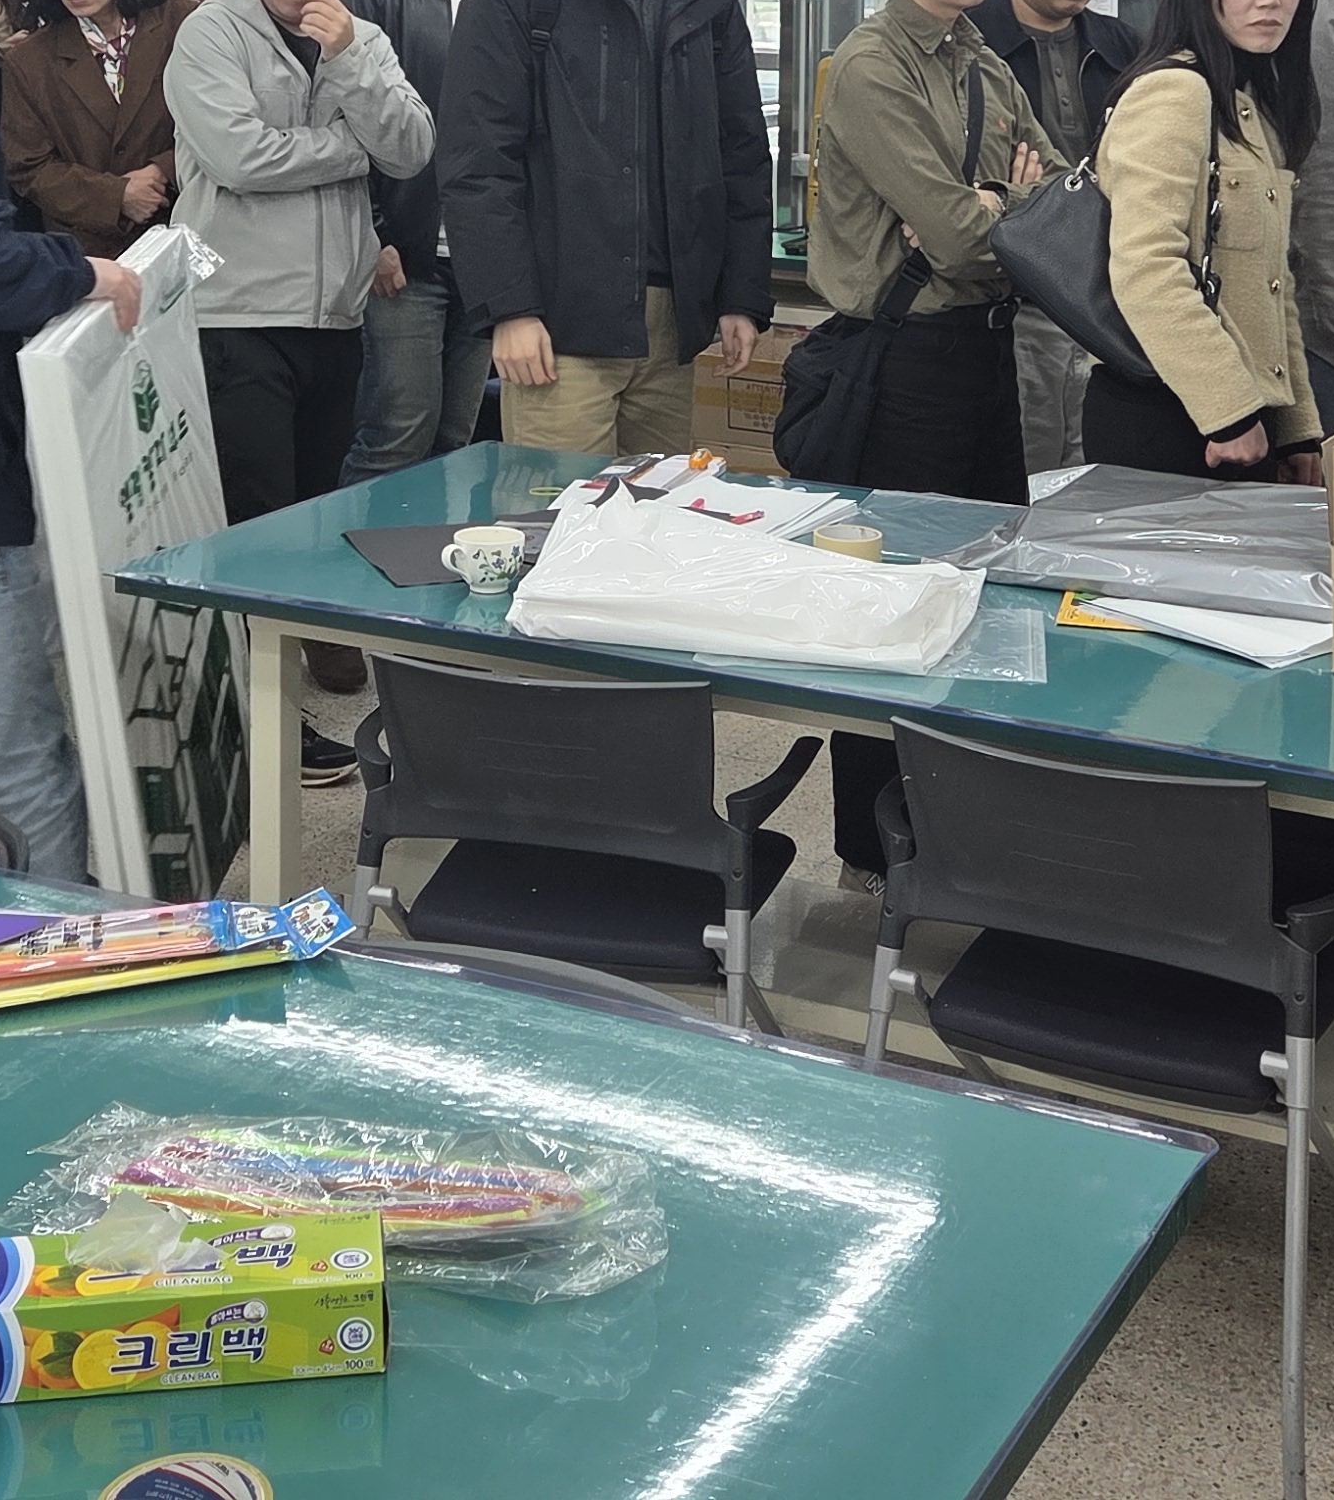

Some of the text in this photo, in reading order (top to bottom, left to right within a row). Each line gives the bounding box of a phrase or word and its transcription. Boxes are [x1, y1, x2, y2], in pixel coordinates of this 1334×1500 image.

[155, 1275, 232, 1287] CLEAN BAG
[345, 1359, 364, 1370] 100
[162, 1371, 220, 1384] CLEAN BAG
